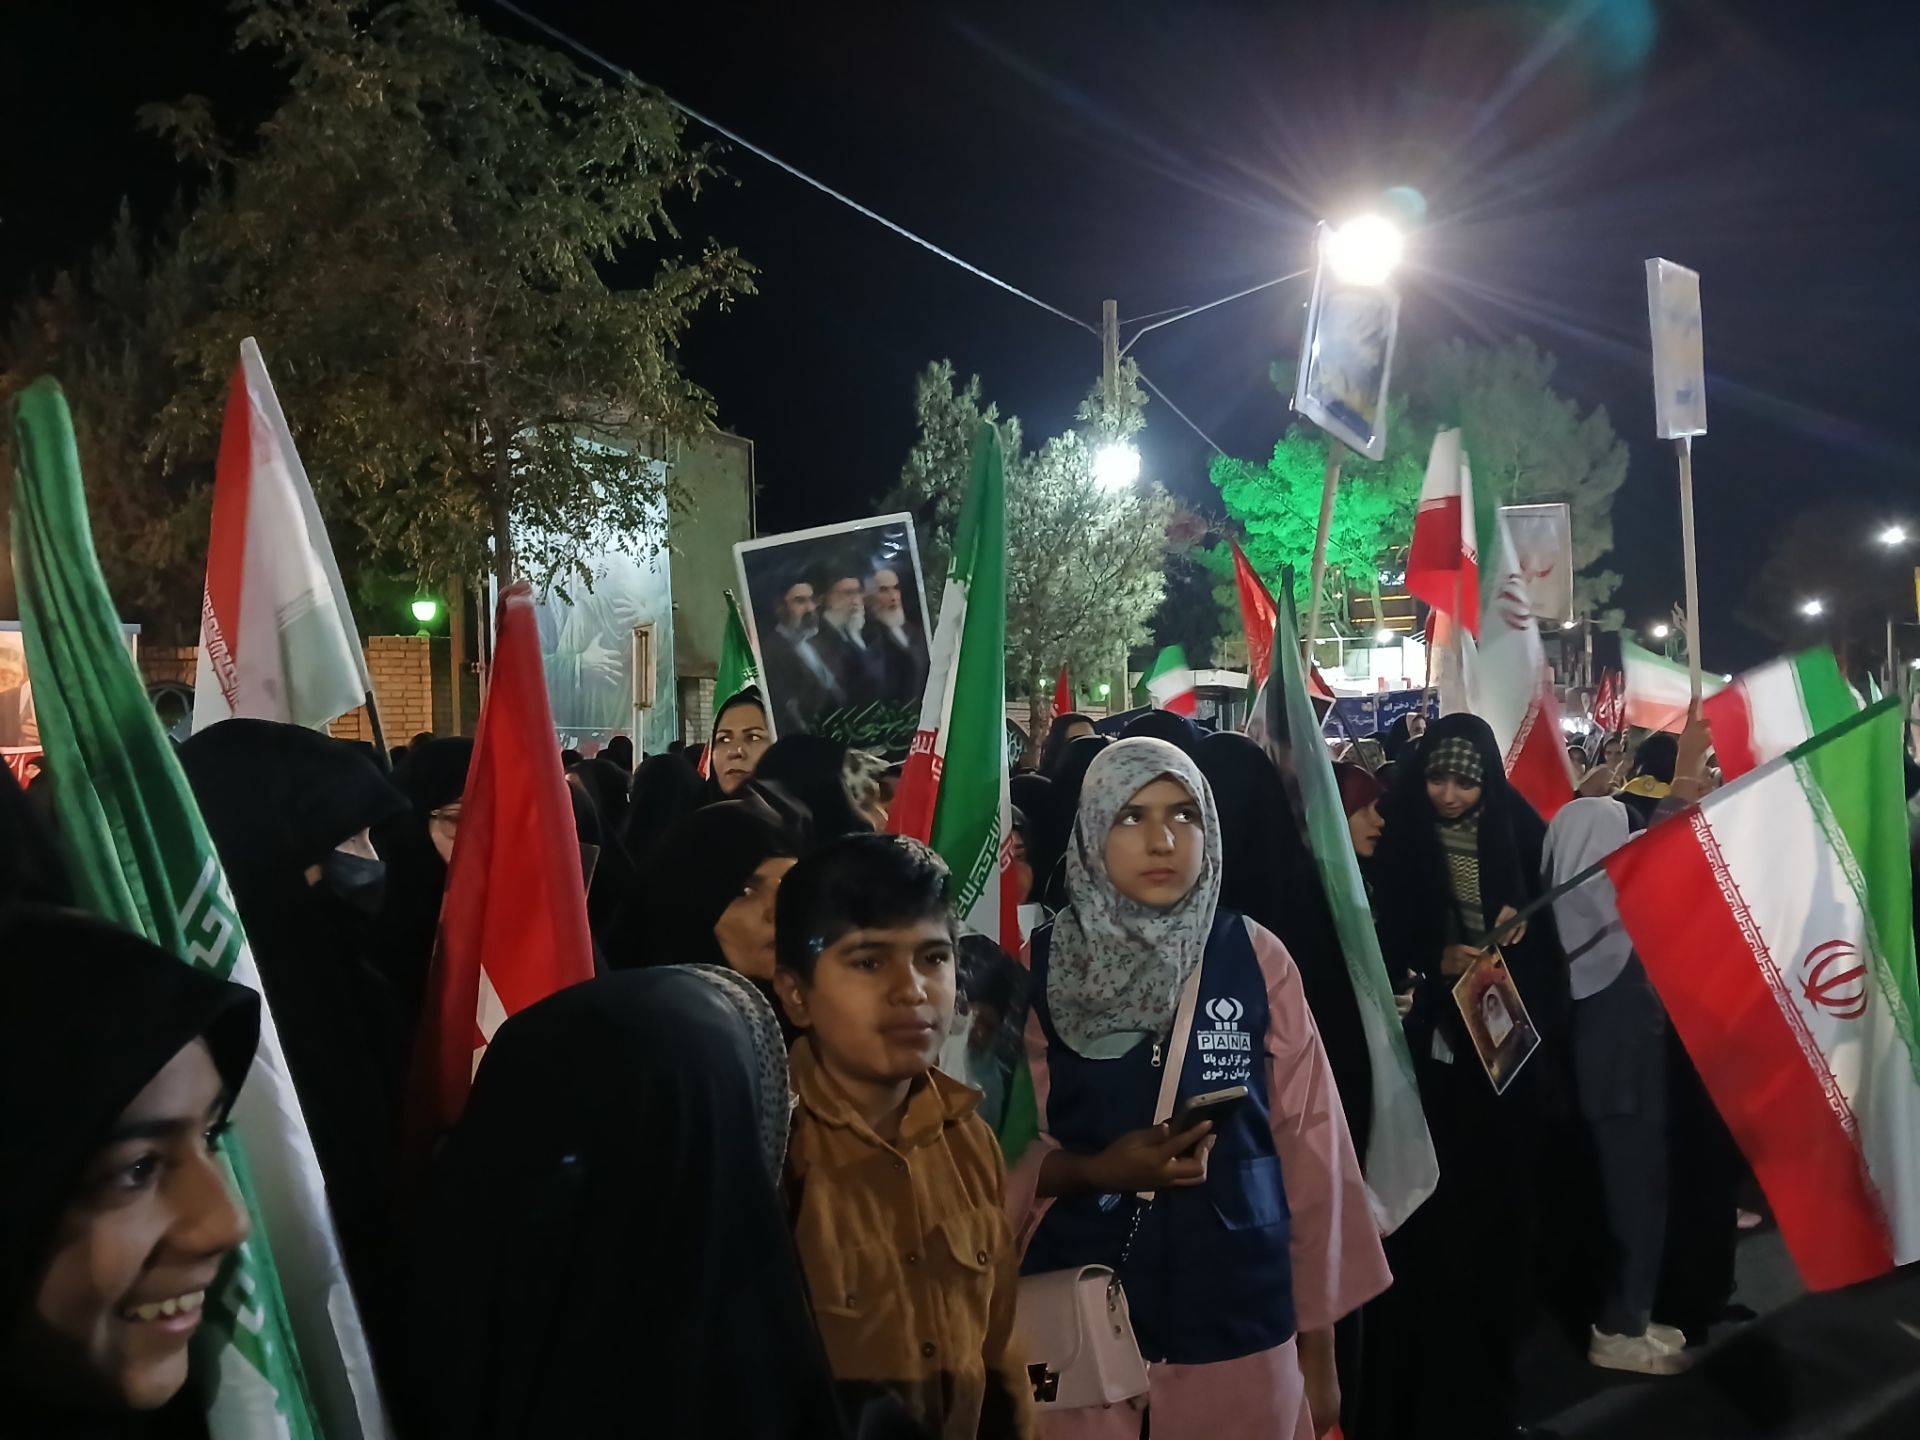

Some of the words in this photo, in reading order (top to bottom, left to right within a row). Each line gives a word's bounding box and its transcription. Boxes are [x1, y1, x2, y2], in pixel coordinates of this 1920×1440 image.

[1199, 1035, 1251, 1050] PANA
[1203, 1053, 1217, 1066] پانا
[1218, 1054, 1251, 1067] خبرگزاری
[1202, 1067, 1228, 1080] رضوی
